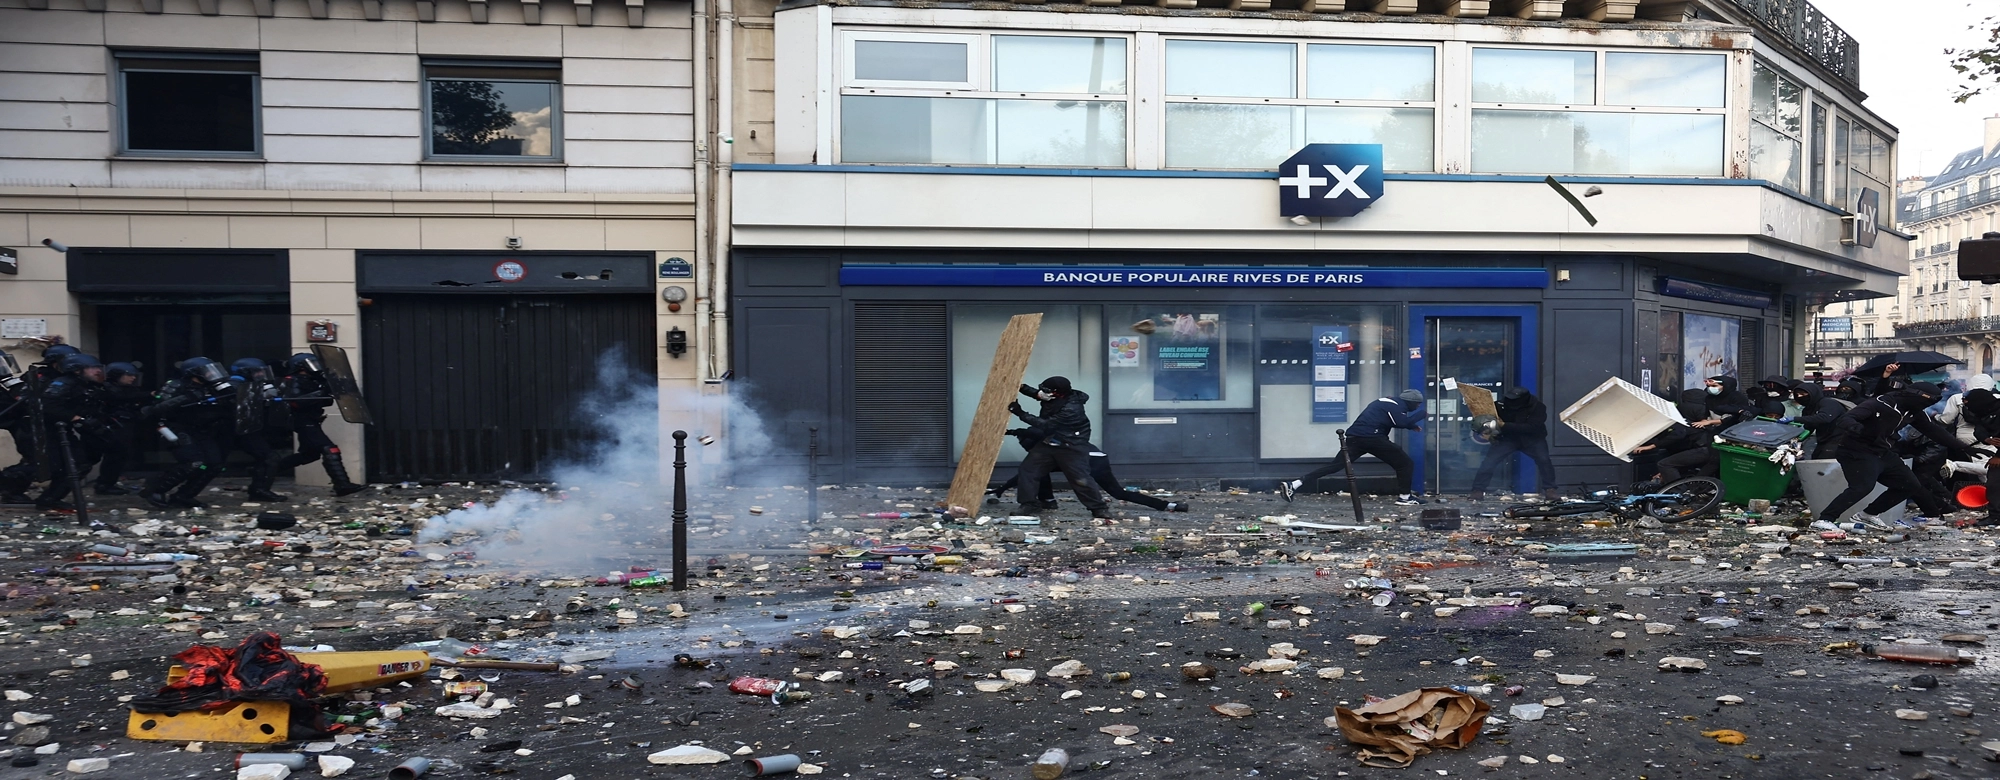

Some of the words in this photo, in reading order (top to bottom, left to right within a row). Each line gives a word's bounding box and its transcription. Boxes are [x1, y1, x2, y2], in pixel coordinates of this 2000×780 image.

[1044, 272, 1123, 283] BANQUE
[1128, 273, 1228, 283] POPULAIRE
[1233, 273, 1282, 283] RIVES
[1286, 274, 1309, 283] DE
[1314, 274, 1363, 284] PARIS
[381, 662, 410, 674] DANGER
